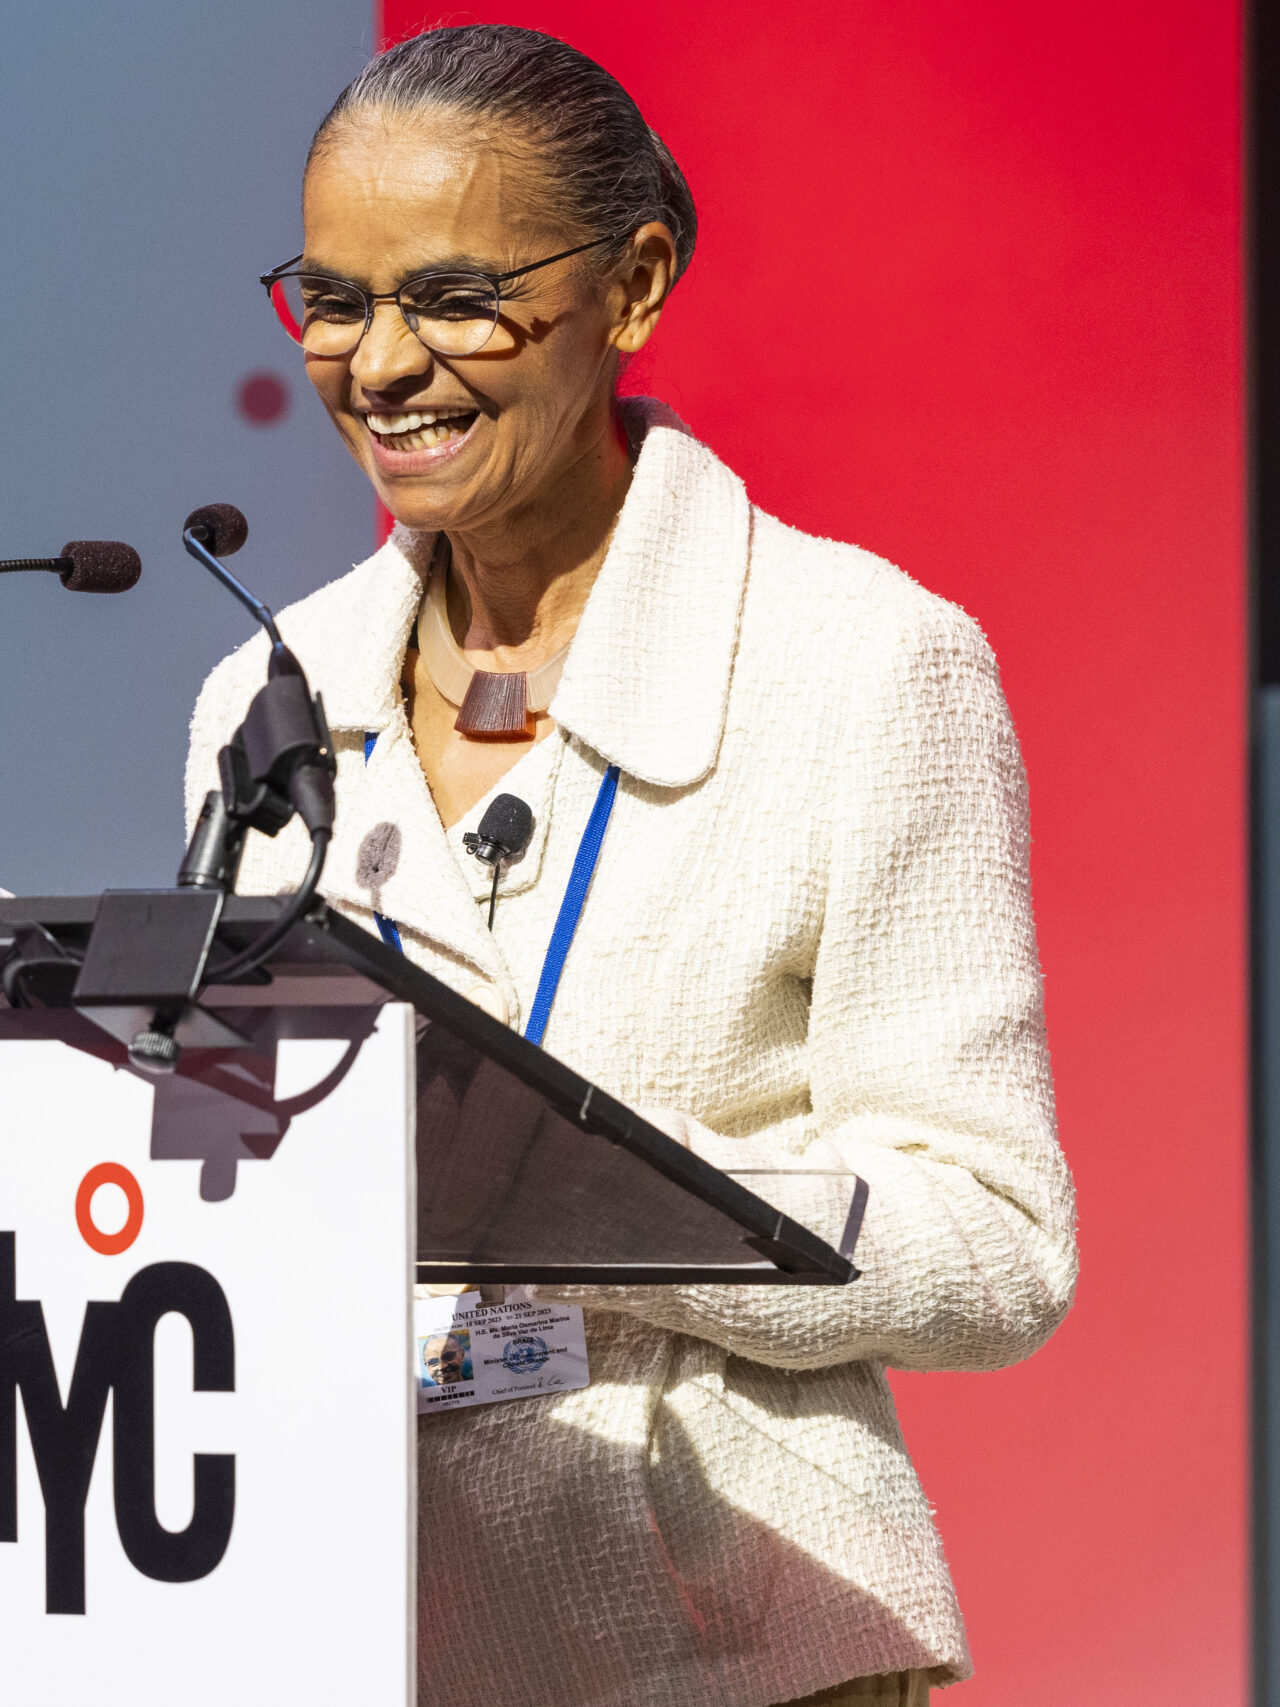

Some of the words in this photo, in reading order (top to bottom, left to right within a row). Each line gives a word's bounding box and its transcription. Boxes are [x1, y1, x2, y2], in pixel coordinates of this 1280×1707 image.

[452, 1309, 488, 1321] UNITED
[490, 1302, 532, 1315] NATIONS
[474, 1318, 487, 1326] SEP
[488, 1316, 502, 1325] 2023
[537, 1308, 552, 1316] 2023
[501, 1324, 518, 1332] Maria
[519, 1319, 548, 1329] Osmarina
[549, 1316, 570, 1324] Marina
[502, 1329, 516, 1338] Silva
[538, 1324, 554, 1332] Lima
[441, 1386, 456, 1394] VIP
[492, 1387, 507, 1396] Chief
